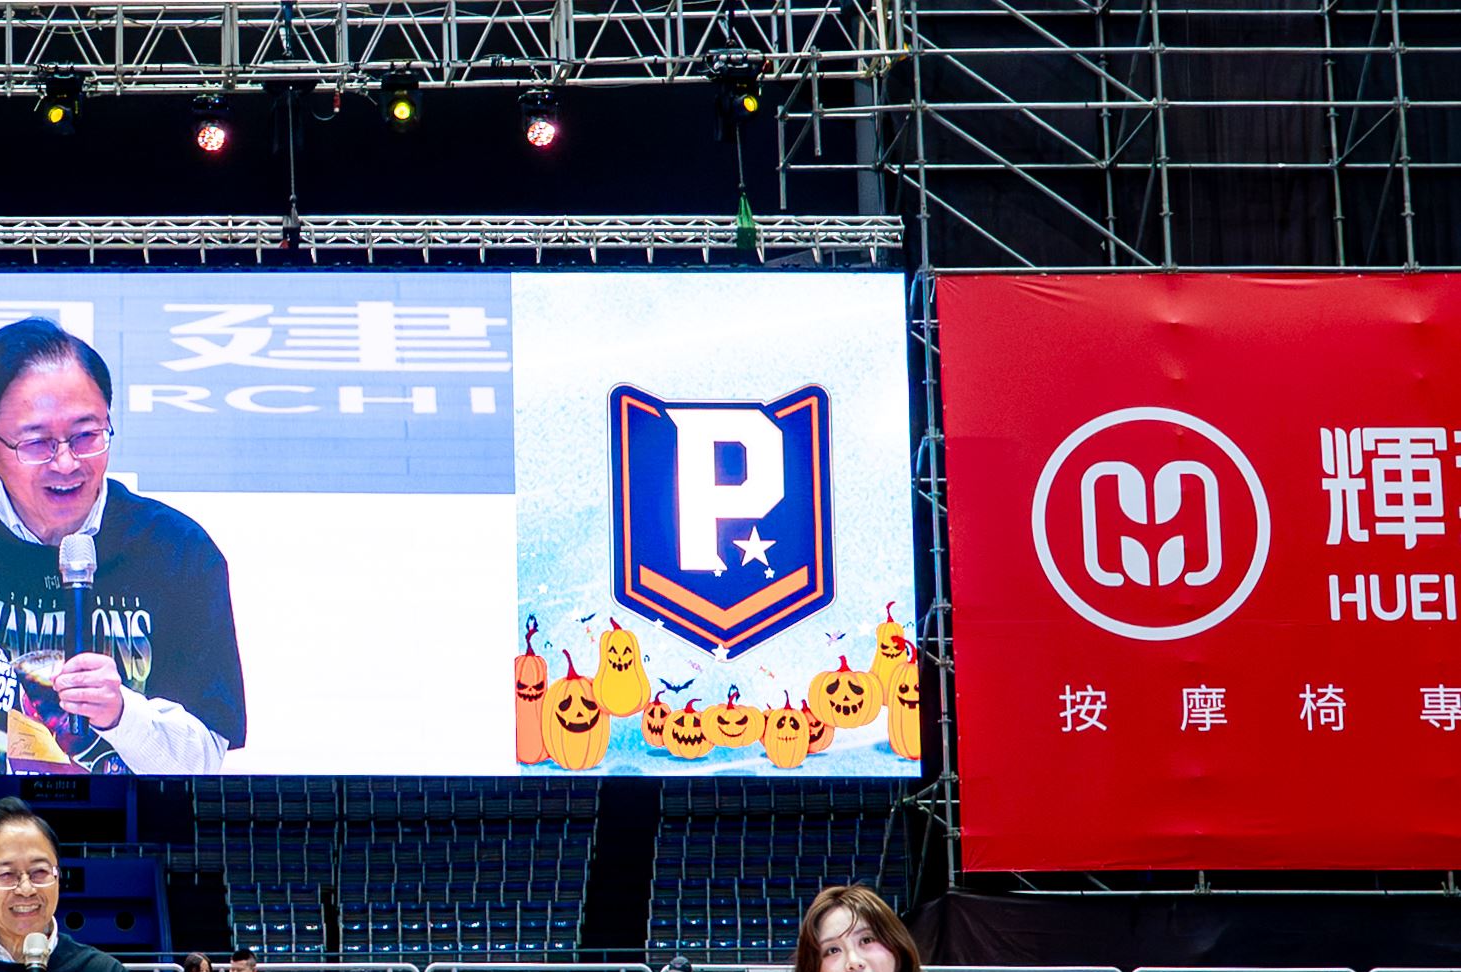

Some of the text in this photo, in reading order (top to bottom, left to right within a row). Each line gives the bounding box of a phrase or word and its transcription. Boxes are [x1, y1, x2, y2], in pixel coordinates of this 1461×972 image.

[129, 384, 496, 413] RCHI
[664, 408, 784, 572] P
[1321, 427, 1461, 549] 輝
[1328, 573, 1457, 621] HUEI
